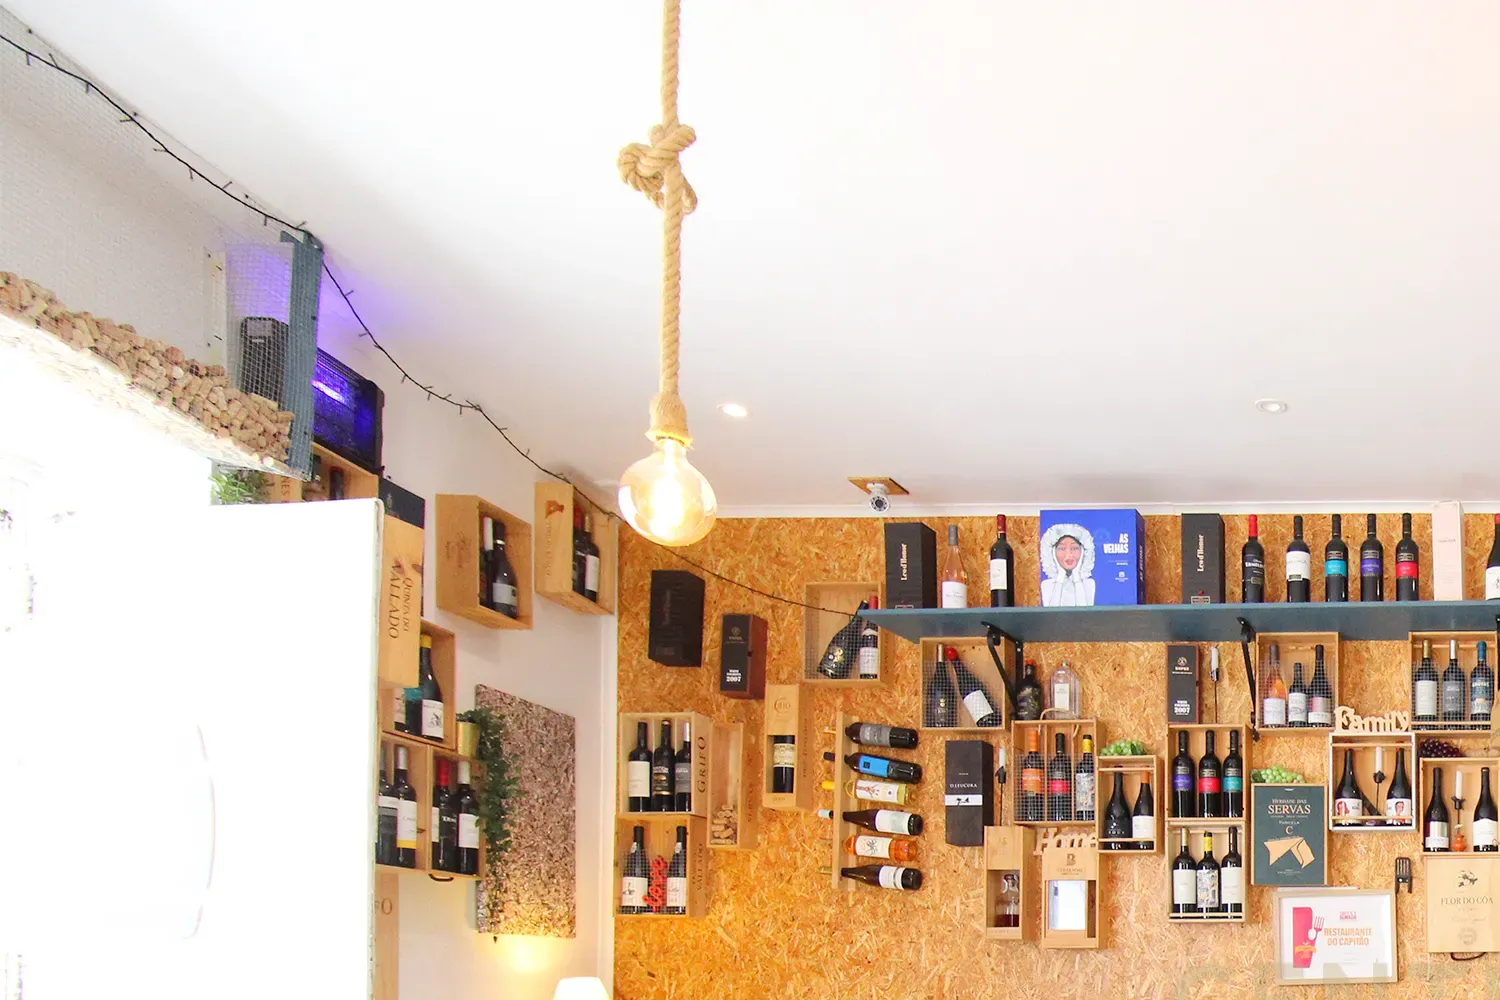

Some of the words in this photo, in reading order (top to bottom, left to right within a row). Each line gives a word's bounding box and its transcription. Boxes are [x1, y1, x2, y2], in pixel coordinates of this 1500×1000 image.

[1118, 533, 1129, 544] AS
[1103, 543, 1129, 554] VELHAS
[387, 564, 401, 639] VALLADO
[1333, 705, 1410, 733] Family
[1267, 804, 1312, 814] SERVAS
[1285, 825, 1294, 835] C
[1323, 927, 1373, 937] RESTAURANTE
[1327, 937, 1338, 946] DO
[1339, 936, 1370, 946] CAPITÃO
